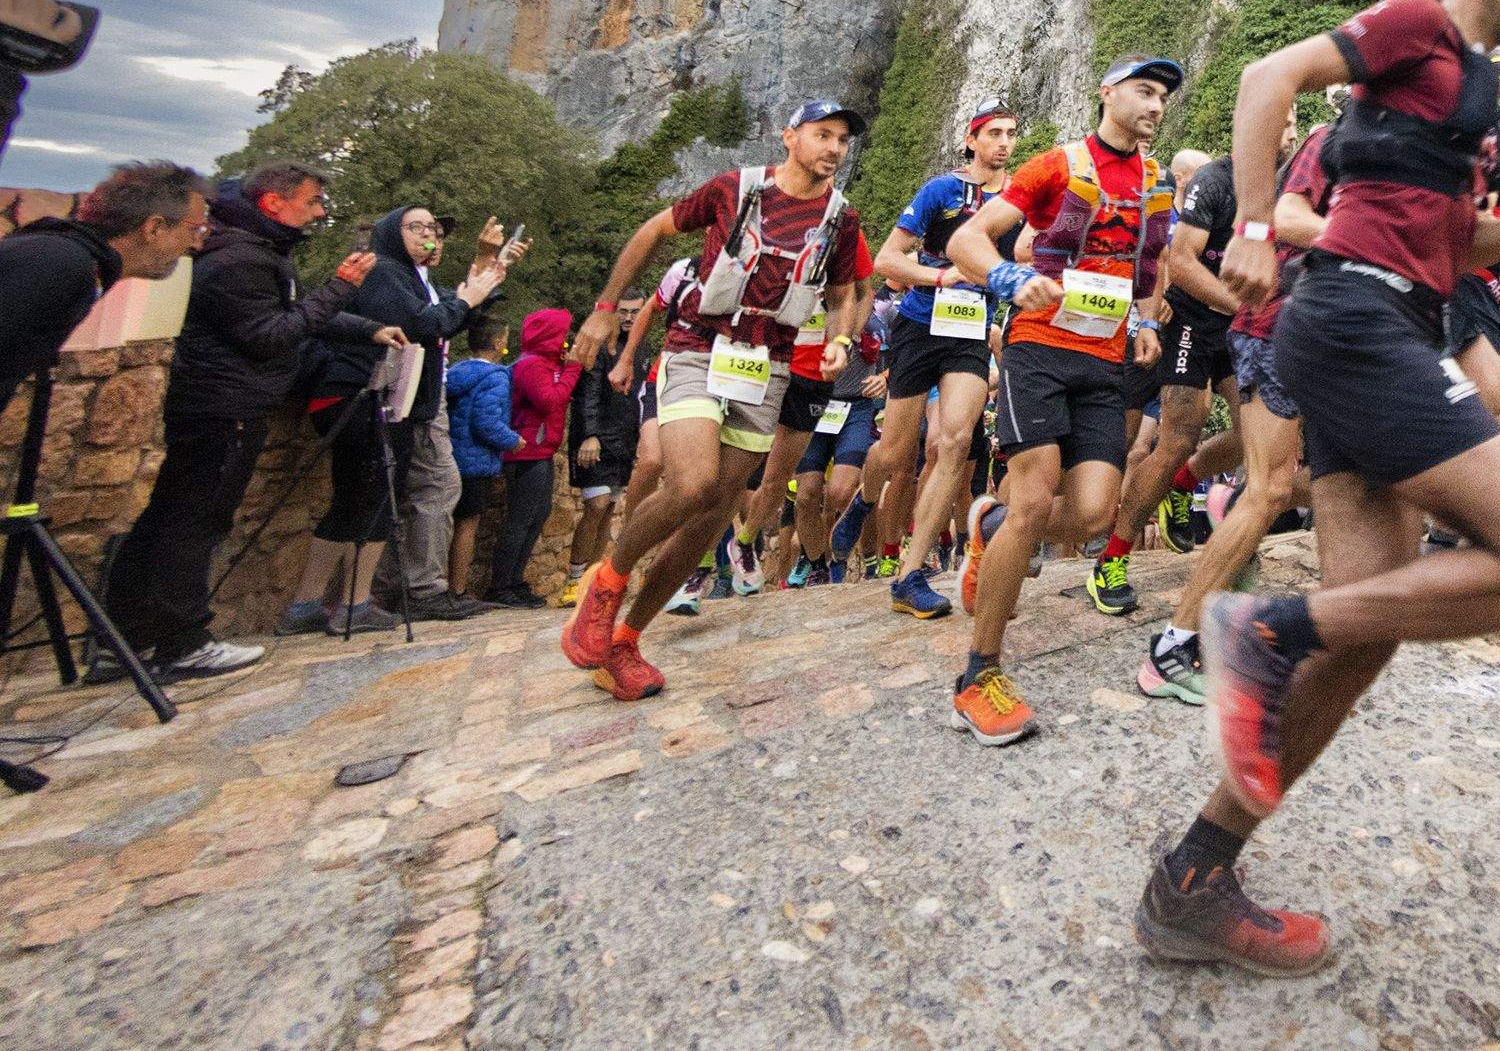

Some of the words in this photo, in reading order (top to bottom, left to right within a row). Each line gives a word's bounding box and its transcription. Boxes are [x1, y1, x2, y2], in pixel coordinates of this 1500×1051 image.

[1081, 293, 1116, 311] 1404
[947, 305, 976, 317] 1083
[729, 357, 764, 374] 1324
